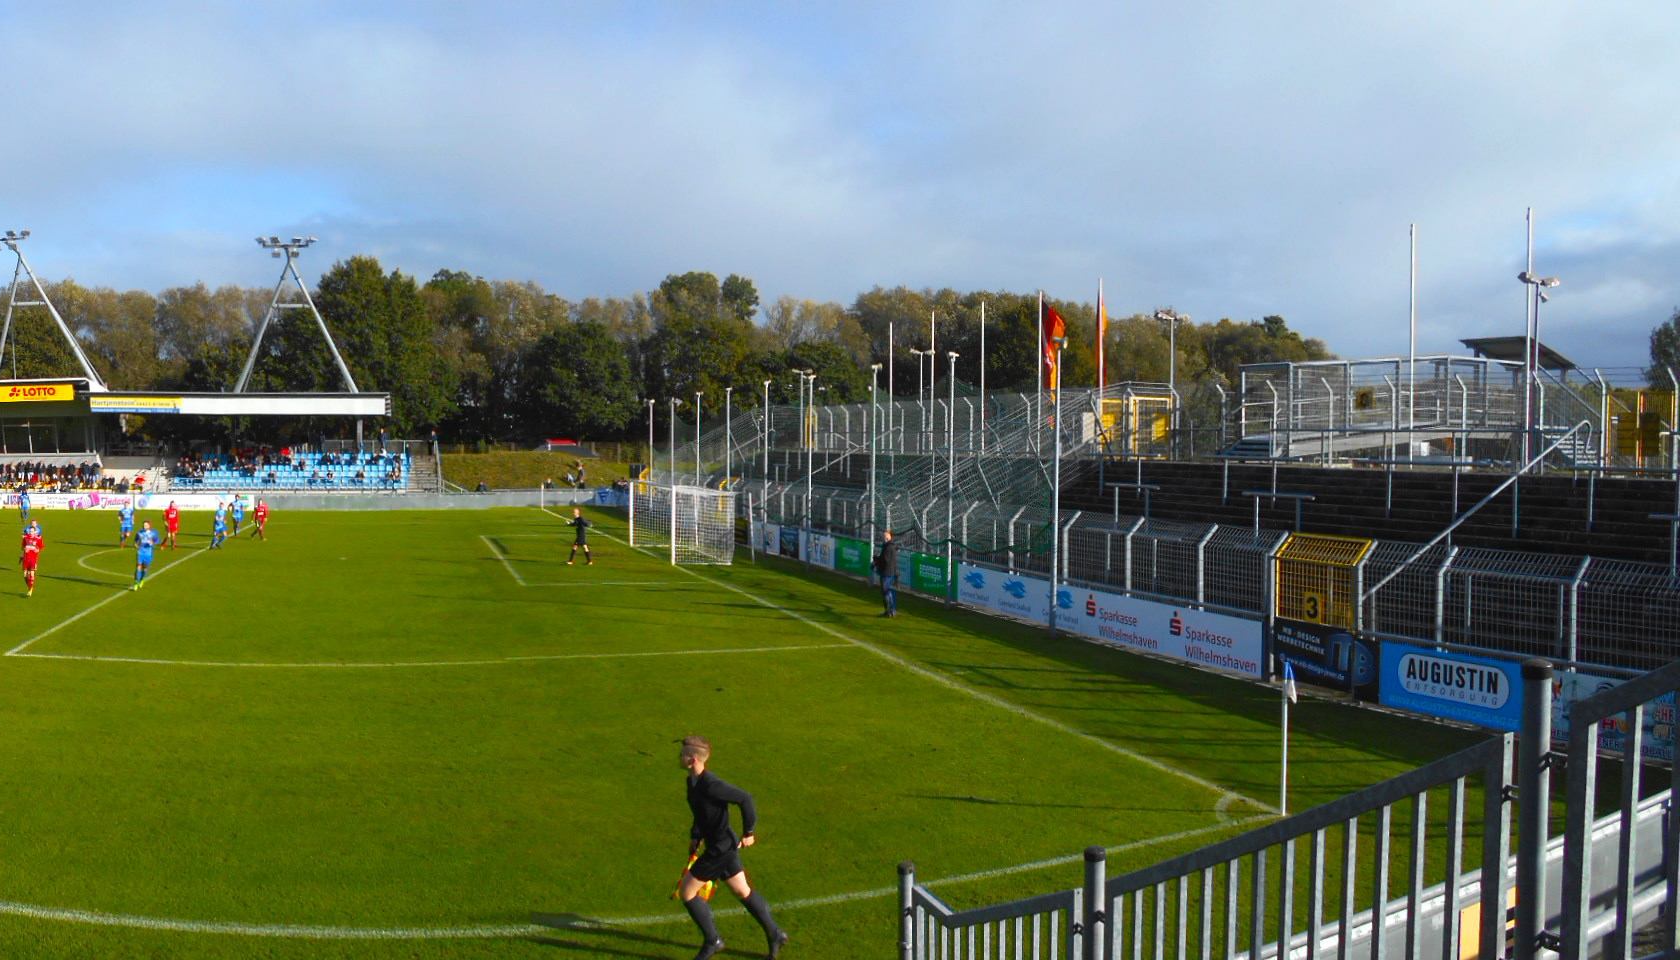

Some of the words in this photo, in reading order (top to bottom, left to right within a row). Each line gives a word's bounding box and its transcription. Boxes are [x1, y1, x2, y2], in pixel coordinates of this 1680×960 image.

[23, 387, 56, 397] LOTTO
[1098, 607, 1138, 628] Sparkasse
[1306, 596, 1319, 620] 3
[1098, 624, 1159, 650] Wilhelmshaven
[1185, 626, 1233, 649] Sparkasse
[1277, 633, 1325, 656] WERBETECHNIK
[1297, 631, 1321, 645] DESIGN
[1184, 644, 1257, 674] Wilhelmshaven
[1406, 657, 1499, 695] AUGUSTIN
[1406, 682, 1499, 706] ENTSORGUNG
[1388, 694, 1520, 729] WWW.AUGUSTIN-ENTSORGUNG.DE
